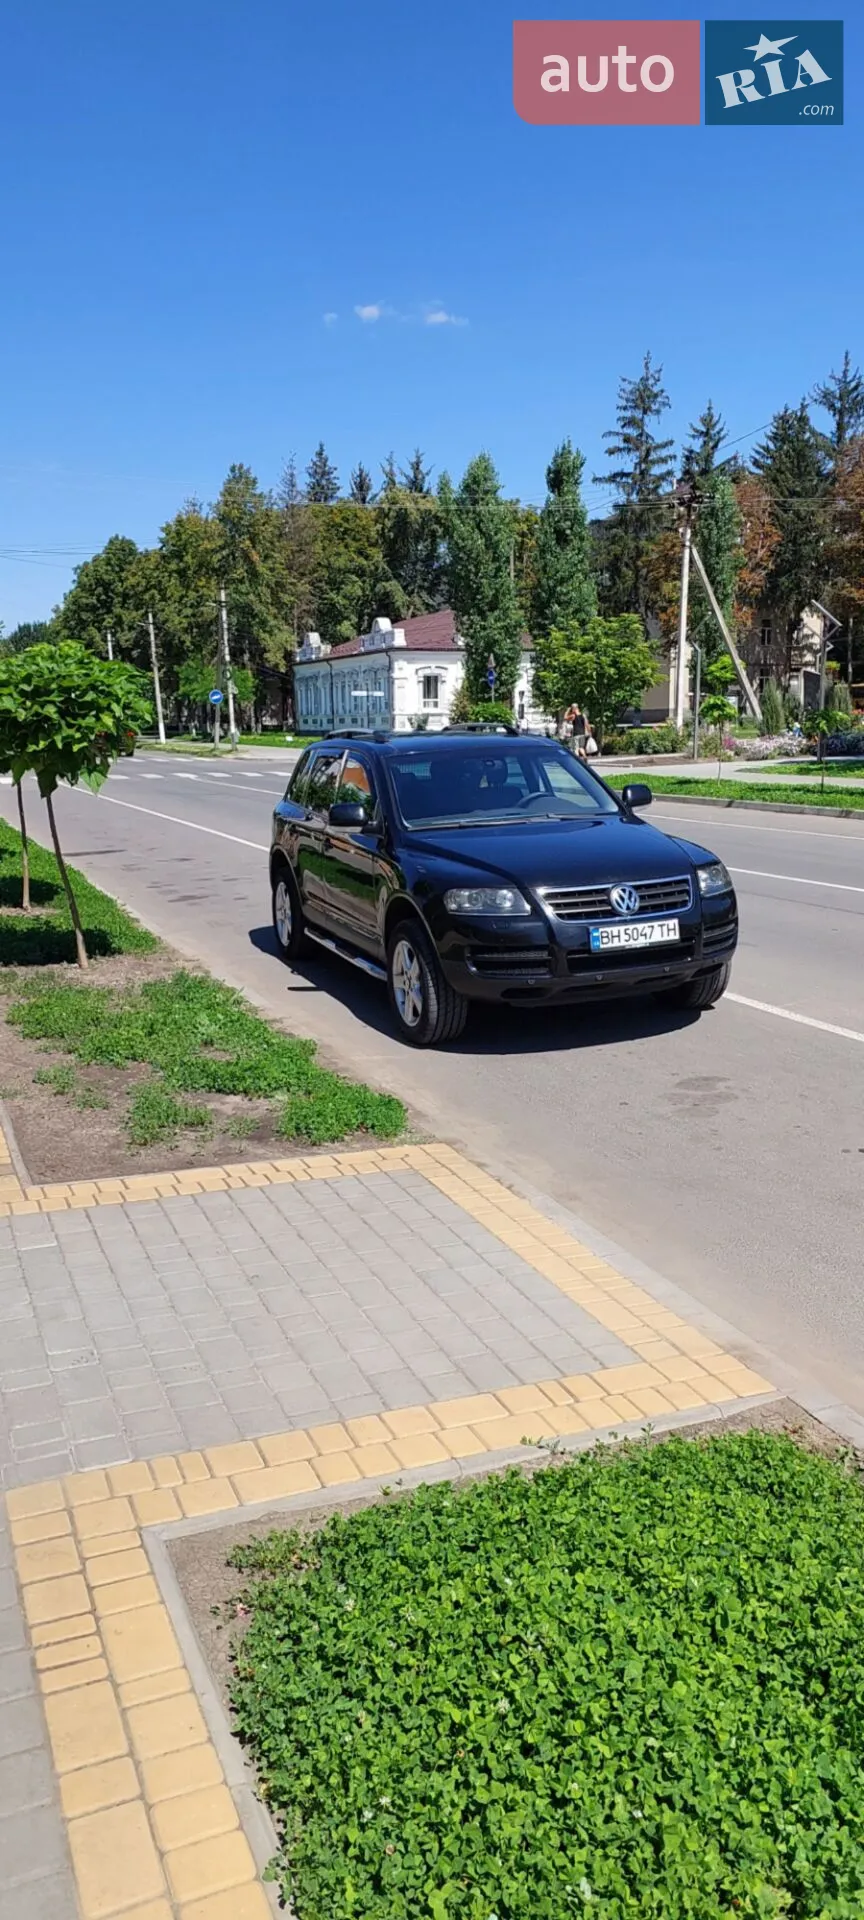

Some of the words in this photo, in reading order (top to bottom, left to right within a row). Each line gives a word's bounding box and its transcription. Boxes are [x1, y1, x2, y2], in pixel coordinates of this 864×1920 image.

[600, 929, 621, 945] BH
[624, 925, 654, 942] 5047
[657, 922, 677, 938] TH
